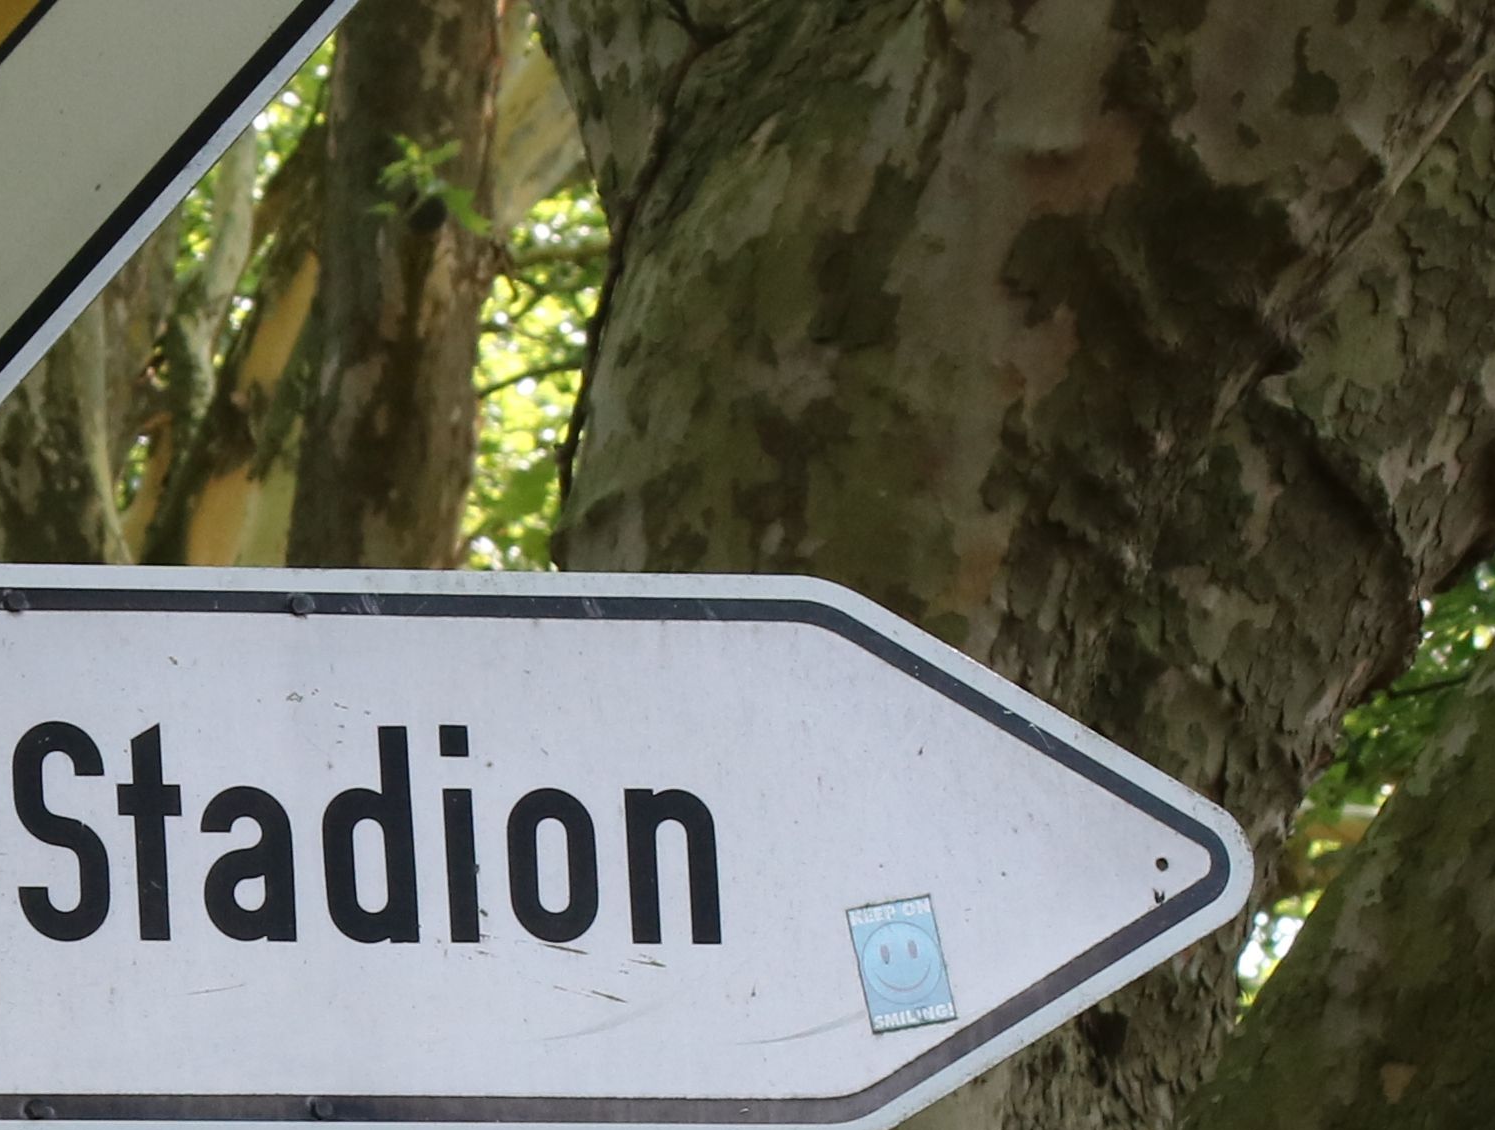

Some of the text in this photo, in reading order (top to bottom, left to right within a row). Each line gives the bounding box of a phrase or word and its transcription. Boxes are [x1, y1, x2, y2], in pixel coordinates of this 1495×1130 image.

[849, 898, 931, 925] KEEP ON
[873, 1002, 956, 1029] SMILING!
